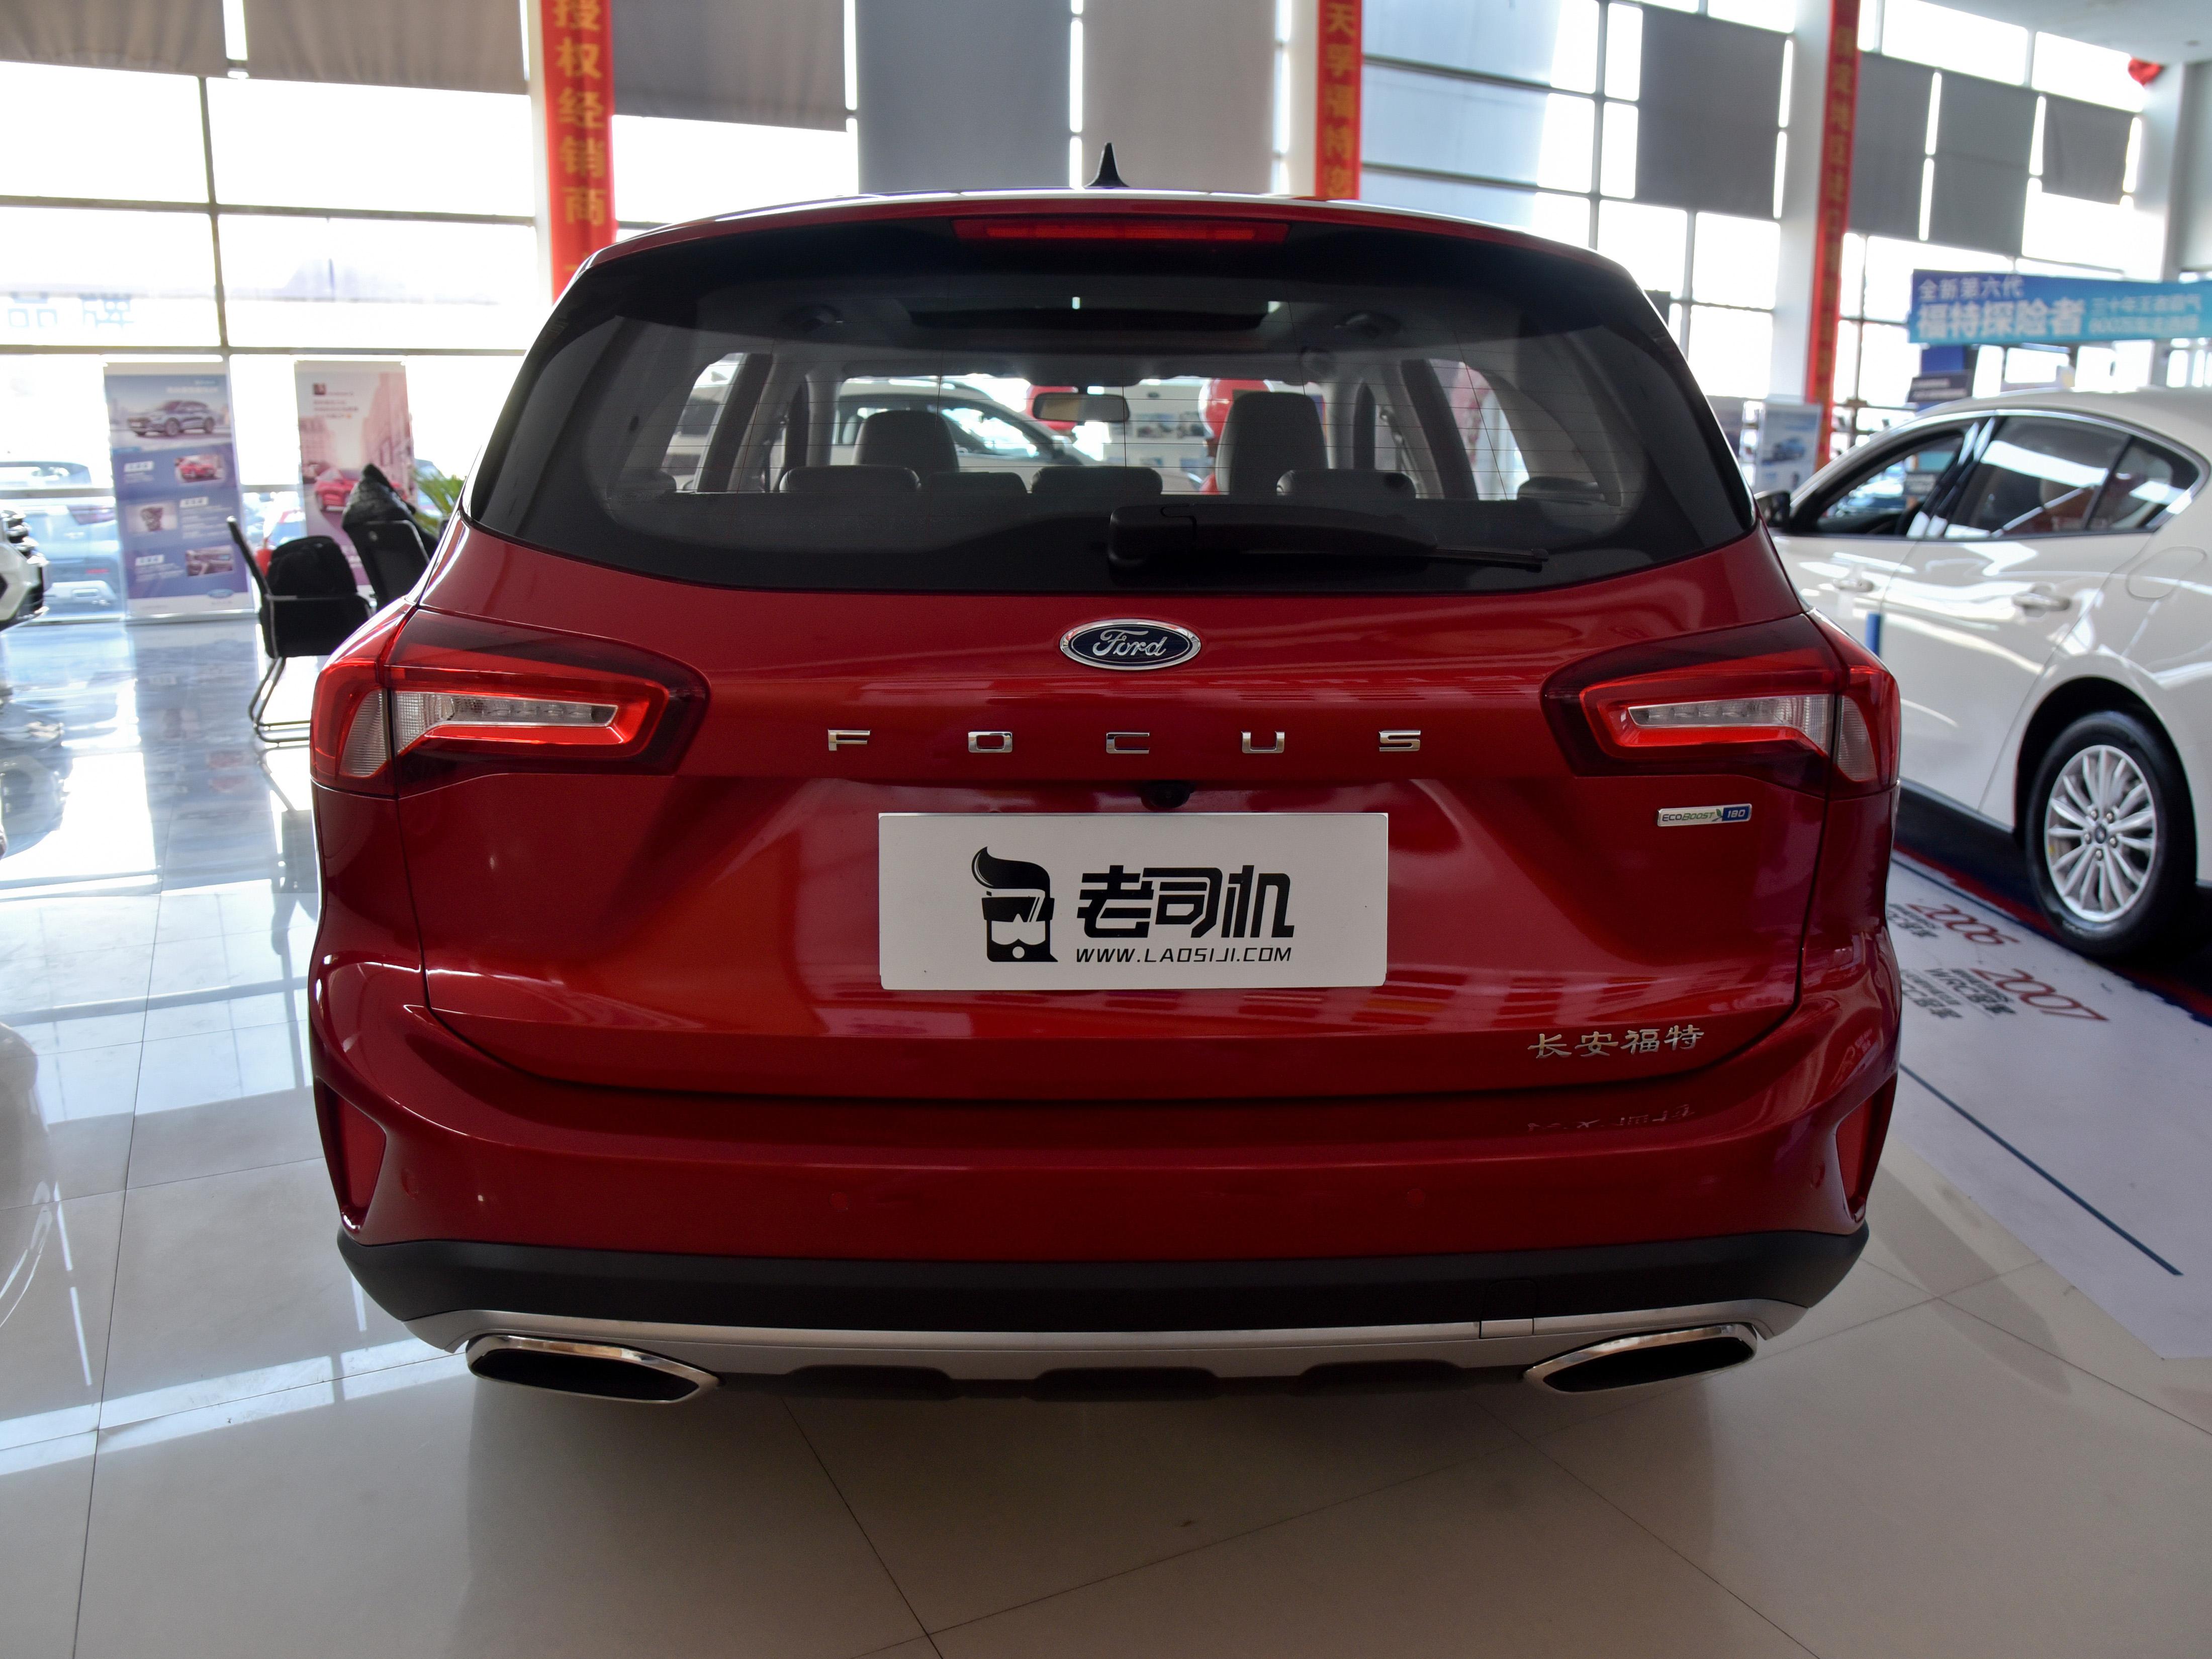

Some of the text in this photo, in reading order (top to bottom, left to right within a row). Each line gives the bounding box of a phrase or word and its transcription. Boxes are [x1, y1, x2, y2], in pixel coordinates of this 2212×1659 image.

[553, 0, 606, 227] 授权经销商
[1919, 273, 2024, 301] 全新第六代
[1917, 297, 2086, 339] 福特探险者
[1092, 629, 1168, 657] Ford
[827, 729, 1422, 754] FOCUS
[1727, 809, 1746, 819] 180
[1077, 865, 1295, 938] 老司机
[1905, 903, 2021, 945] 2006
[1076, 947, 1292, 963] WWW.LAOSIJI.COM
[1969, 967, 2110, 1022] 2007
[1527, 1024, 1705, 1059] 长安福特
